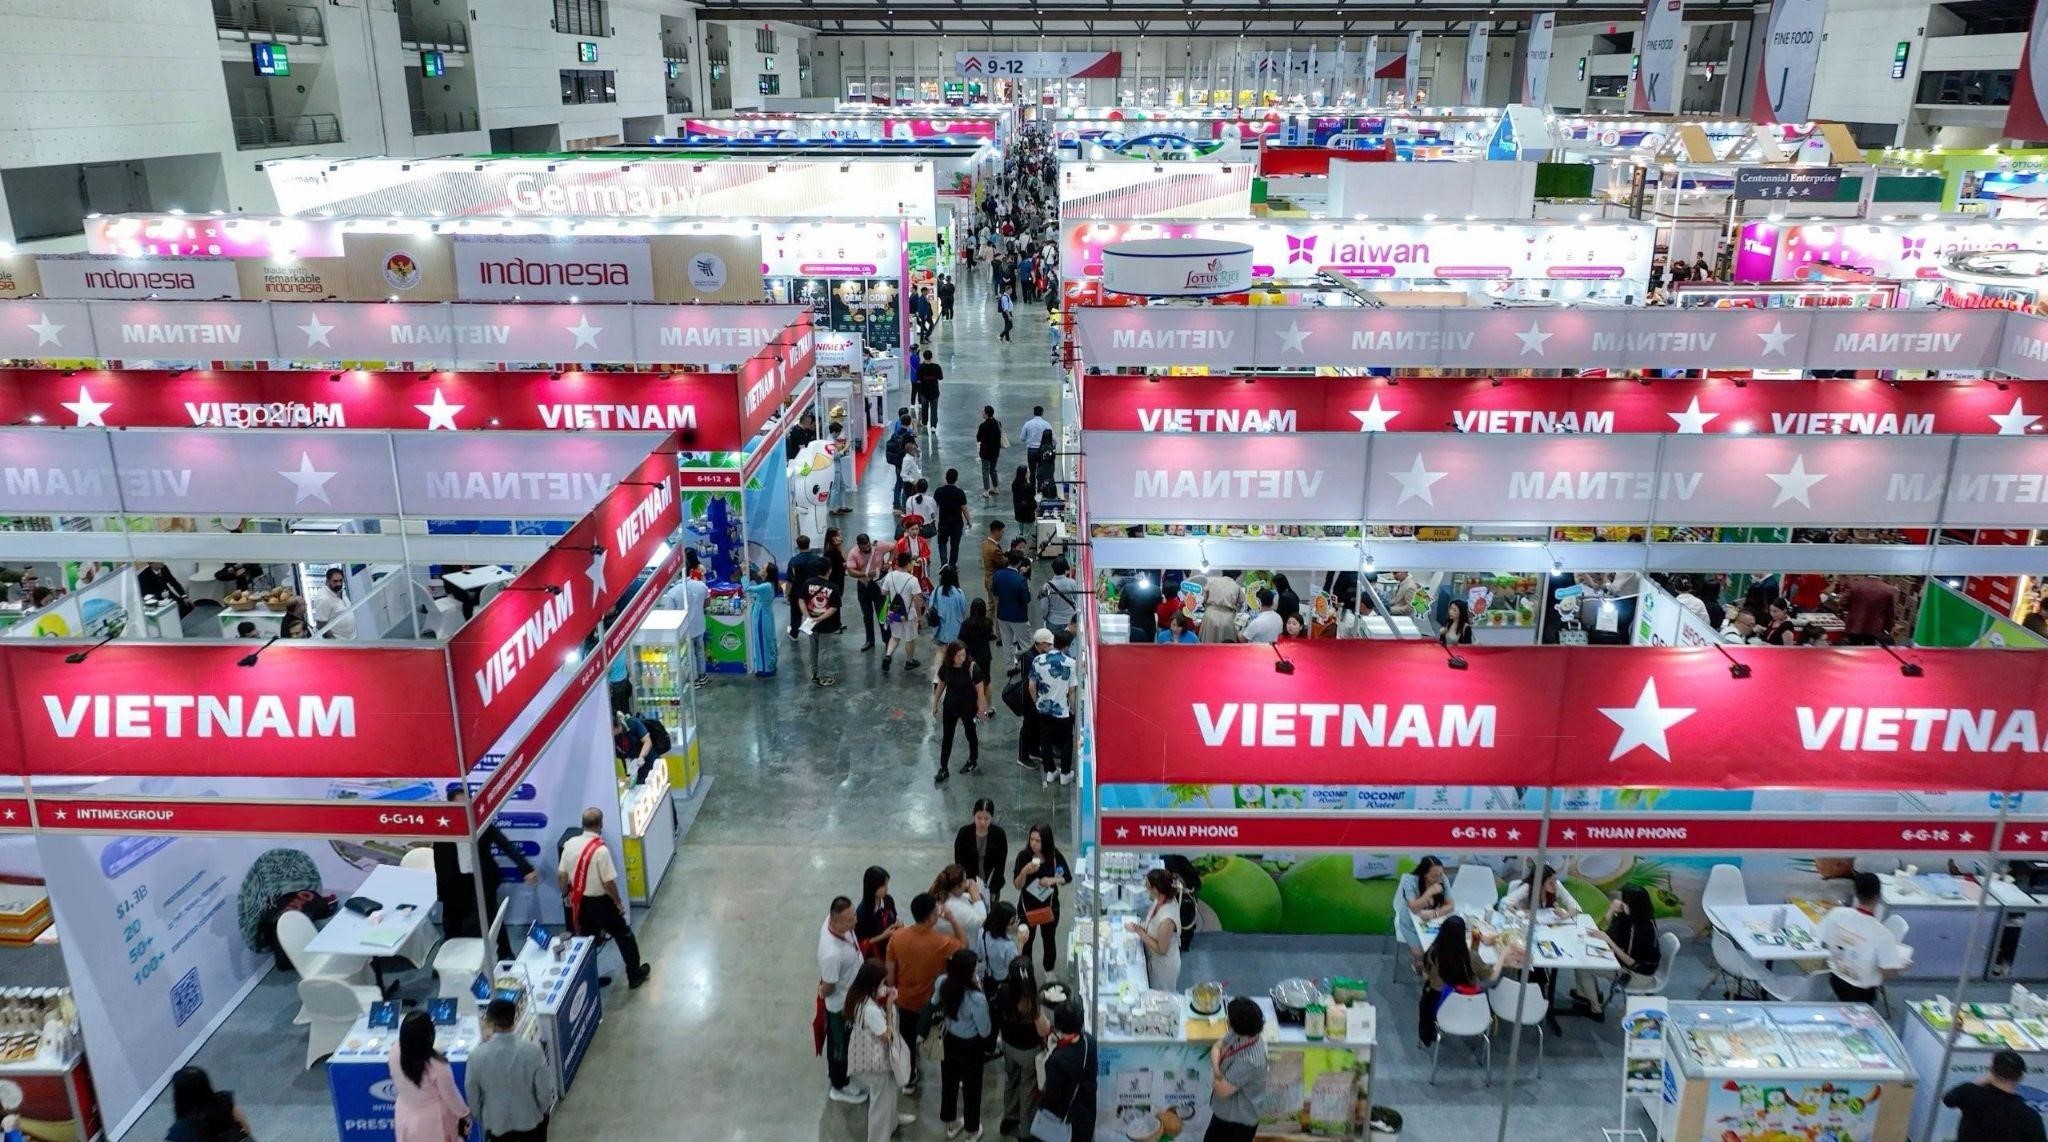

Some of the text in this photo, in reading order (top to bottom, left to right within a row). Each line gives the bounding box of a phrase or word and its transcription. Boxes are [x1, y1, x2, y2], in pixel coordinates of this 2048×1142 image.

[1646, 38, 1673, 51] FINE FOOD
[1774, 30, 1814, 45] FINE FOOD
[988, 60, 1023, 73] 9-12
[1647, 73, 1661, 102] K
[1774, 67, 1789, 112] J
[1740, 173, 1837, 185] Centennial Enterprise
[506, 172, 704, 214] Germany
[1759, 186, 1811, 198] 百年企业
[1329, 235, 1430, 264] Taiwan
[84, 268, 195, 289] indonesia
[264, 274, 321, 284] remarkable
[480, 257, 629, 286] indonesia
[265, 283, 323, 293] indonesia
[814, 342, 846, 352] NIMEX
[745, 367, 775, 418] VIETNAM
[537, 404, 698, 429] VIETNAM
[1137, 408, 1297, 432] VIETNAM
[1453, 410, 1615, 433] VIETNAM
[1771, 412, 1936, 435] VIETNAM
[697, 474, 722, 483] 6-H-12
[615, 475, 672, 558] VIETNAM
[474, 580, 575, 708] VIETNAM
[42, 694, 355, 738] VIETNAM
[1191, 703, 1497, 748] VIETNAM
[1795, 706, 2048, 753] VIETNA
[1312, 790, 1348, 798] COCONUT
[1358, 790, 1406, 801] COCONUT
[76, 808, 174, 820] INTIMEXGROUP
[379, 814, 425, 825] 6-G-14
[1139, 825, 1239, 838] THUAN PHONG
[1451, 827, 1497, 839] 6-G-16
[1586, 827, 1688, 840] THUAN PHONG
[1901, 829, 1950, 842] 6-G-16
[123, 919, 141, 943] 20
